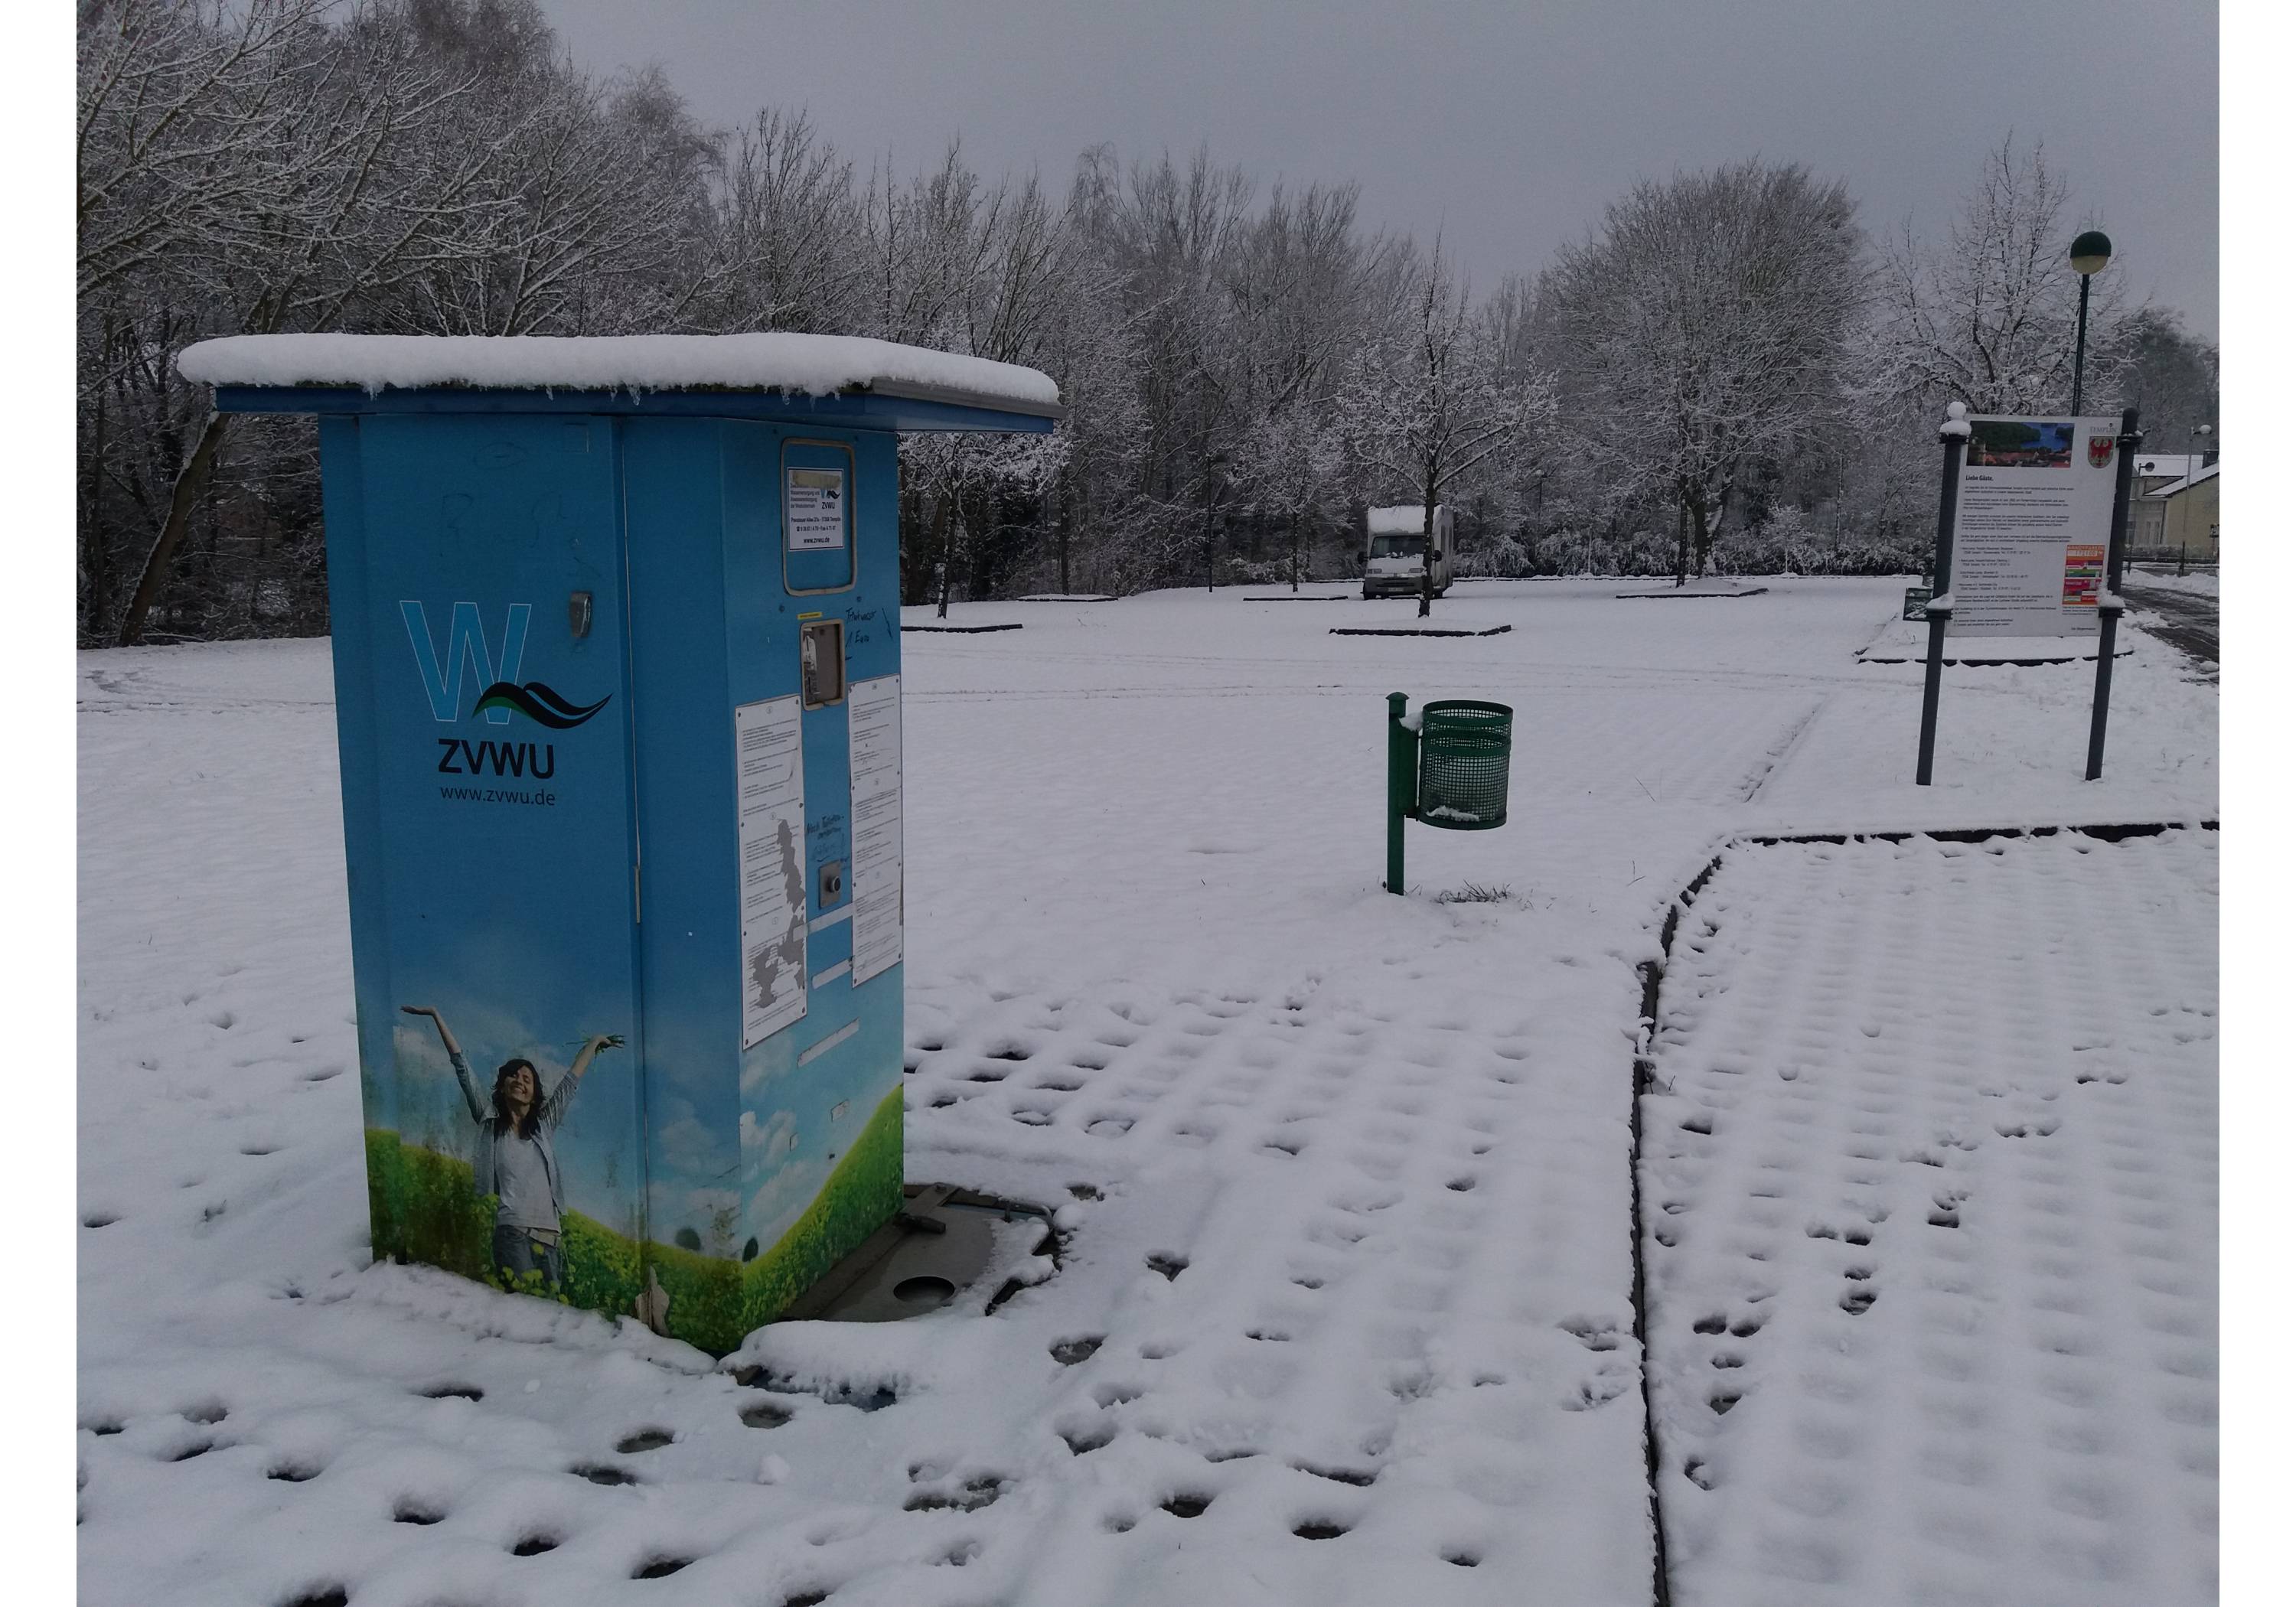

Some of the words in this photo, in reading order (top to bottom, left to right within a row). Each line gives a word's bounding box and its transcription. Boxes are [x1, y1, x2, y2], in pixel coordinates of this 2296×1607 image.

[821, 501, 836, 510] ZVWU
[400, 600, 532, 725] W
[438, 738, 554, 779] ZVWU
[440, 786, 556, 806] www.zvwu.de
